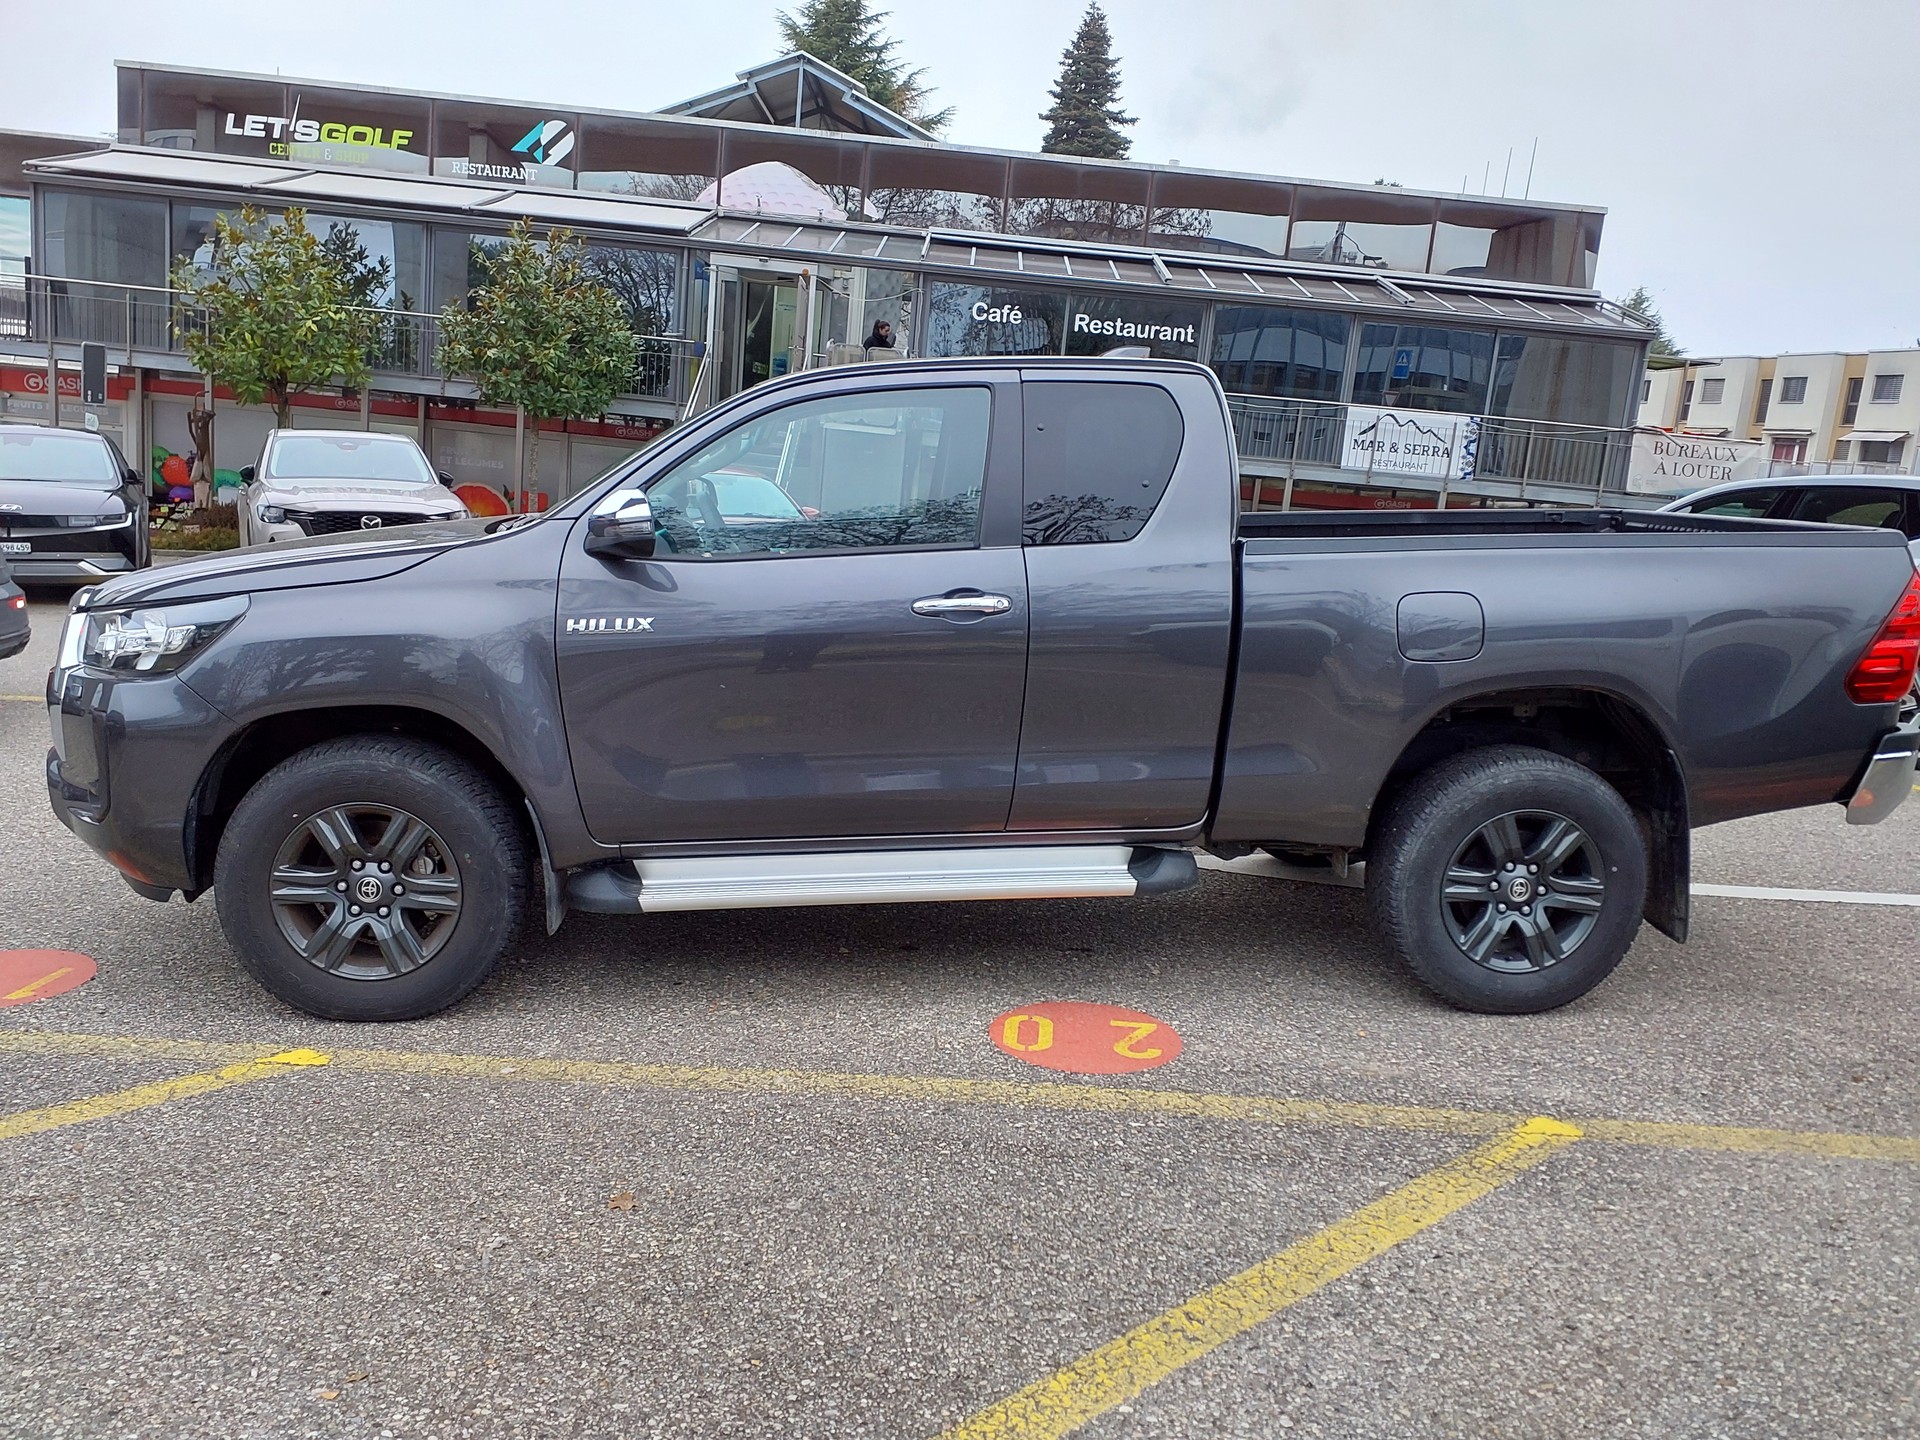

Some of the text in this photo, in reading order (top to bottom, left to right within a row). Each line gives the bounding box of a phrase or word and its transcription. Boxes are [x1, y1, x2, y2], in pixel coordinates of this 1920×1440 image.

[324, 148, 332, 161] &
[451, 161, 538, 180] RESTAURANT
[972, 302, 1195, 343] Café Restaurant
[626, 427, 653, 437] GASHI
[1352, 438, 1451, 459] MAR & SERRA
[1653, 441, 1739, 462] BUREAUX
[1372, 459, 1429, 471] RESTAURANT
[1654, 457, 1732, 481] À LOUER
[1385, 499, 1412, 509] GASHI
[566, 617, 655, 633] HILUX
